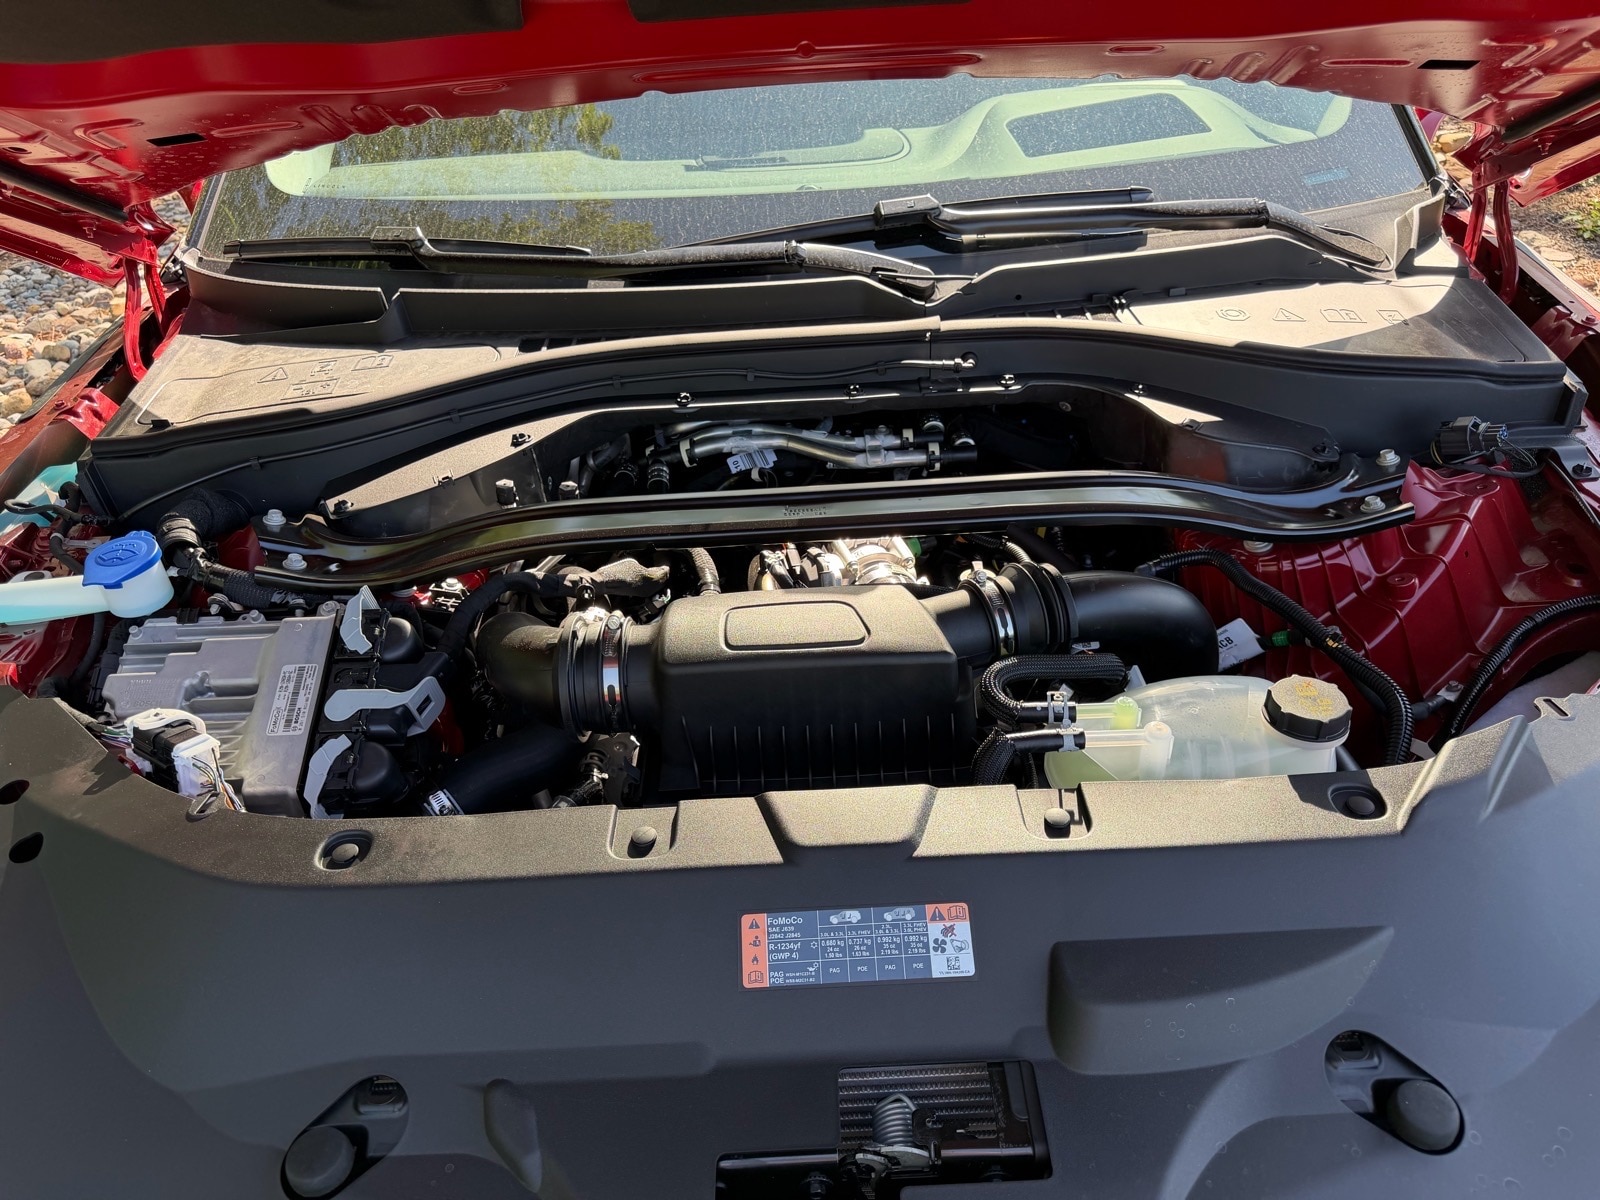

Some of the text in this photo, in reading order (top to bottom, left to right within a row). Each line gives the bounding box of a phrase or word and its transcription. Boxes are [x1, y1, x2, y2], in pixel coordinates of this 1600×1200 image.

[270, 710, 280, 732] FoMoCo
[768, 916, 802, 925] FoMoCo
[769, 942, 801, 950] R-1234yf
[770, 952, 799, 961] (GWP 4)
